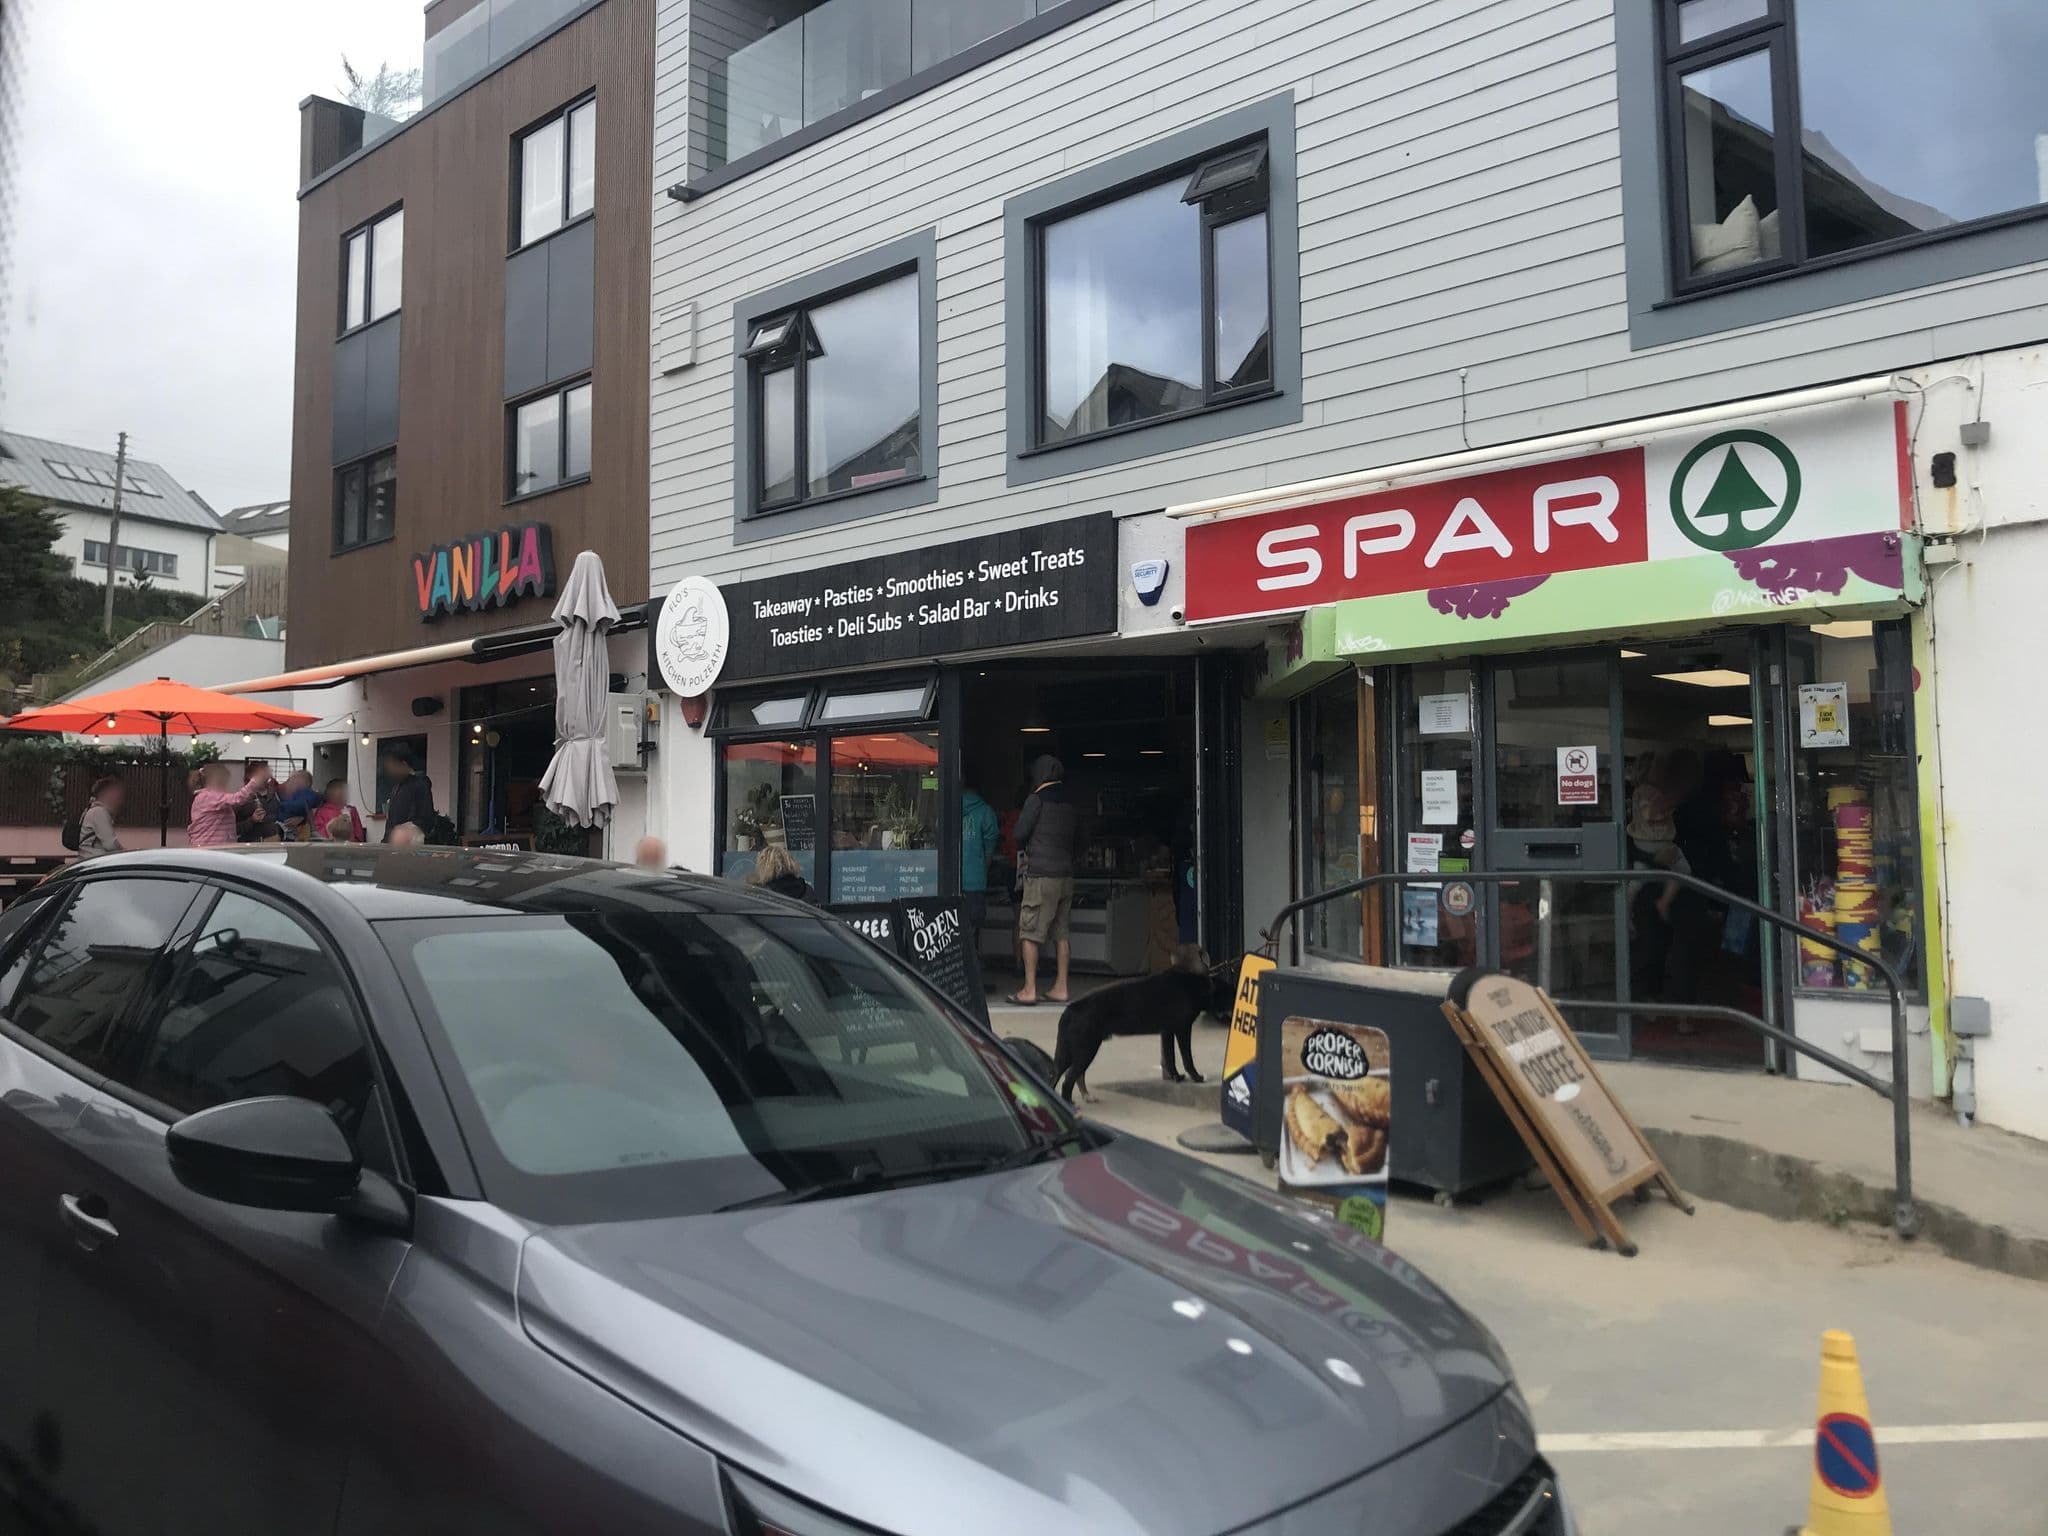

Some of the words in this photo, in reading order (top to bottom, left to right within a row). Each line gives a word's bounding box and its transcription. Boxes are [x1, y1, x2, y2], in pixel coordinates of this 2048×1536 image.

[1256, 476, 1620, 592] SPAR
[414, 527, 543, 612] VANILLA
[753, 597, 812, 619] Takeaway
[824, 585, 873, 608] Pasties
[886, 569, 964, 598] Smoothies
[978, 556, 1028, 582] Sweet
[1031, 547, 1085, 572] Treats
[668, 588, 689, 613] FLO'S
[770, 625, 823, 647] Toasties
[838, 616, 865, 638] Deli
[867, 611, 902, 633] Subs
[918, 600, 960, 626] Salad
[964, 598, 991, 619] Bar
[1005, 586, 1059, 612] Drinks
[662, 651, 686, 687] KITCHEN
[689, 643, 722, 687] POLZEATH
[1574, 779, 1593, 789] dogs
[913, 908, 960, 953] OPEN
[925, 928, 954, 961] DAILY
[1239, 976, 1259, 1006] AT
[1233, 1008, 1257, 1039] HER
[1308, 1032, 1362, 1061] PROPER
[1306, 1052, 1364, 1079] CORNISH
